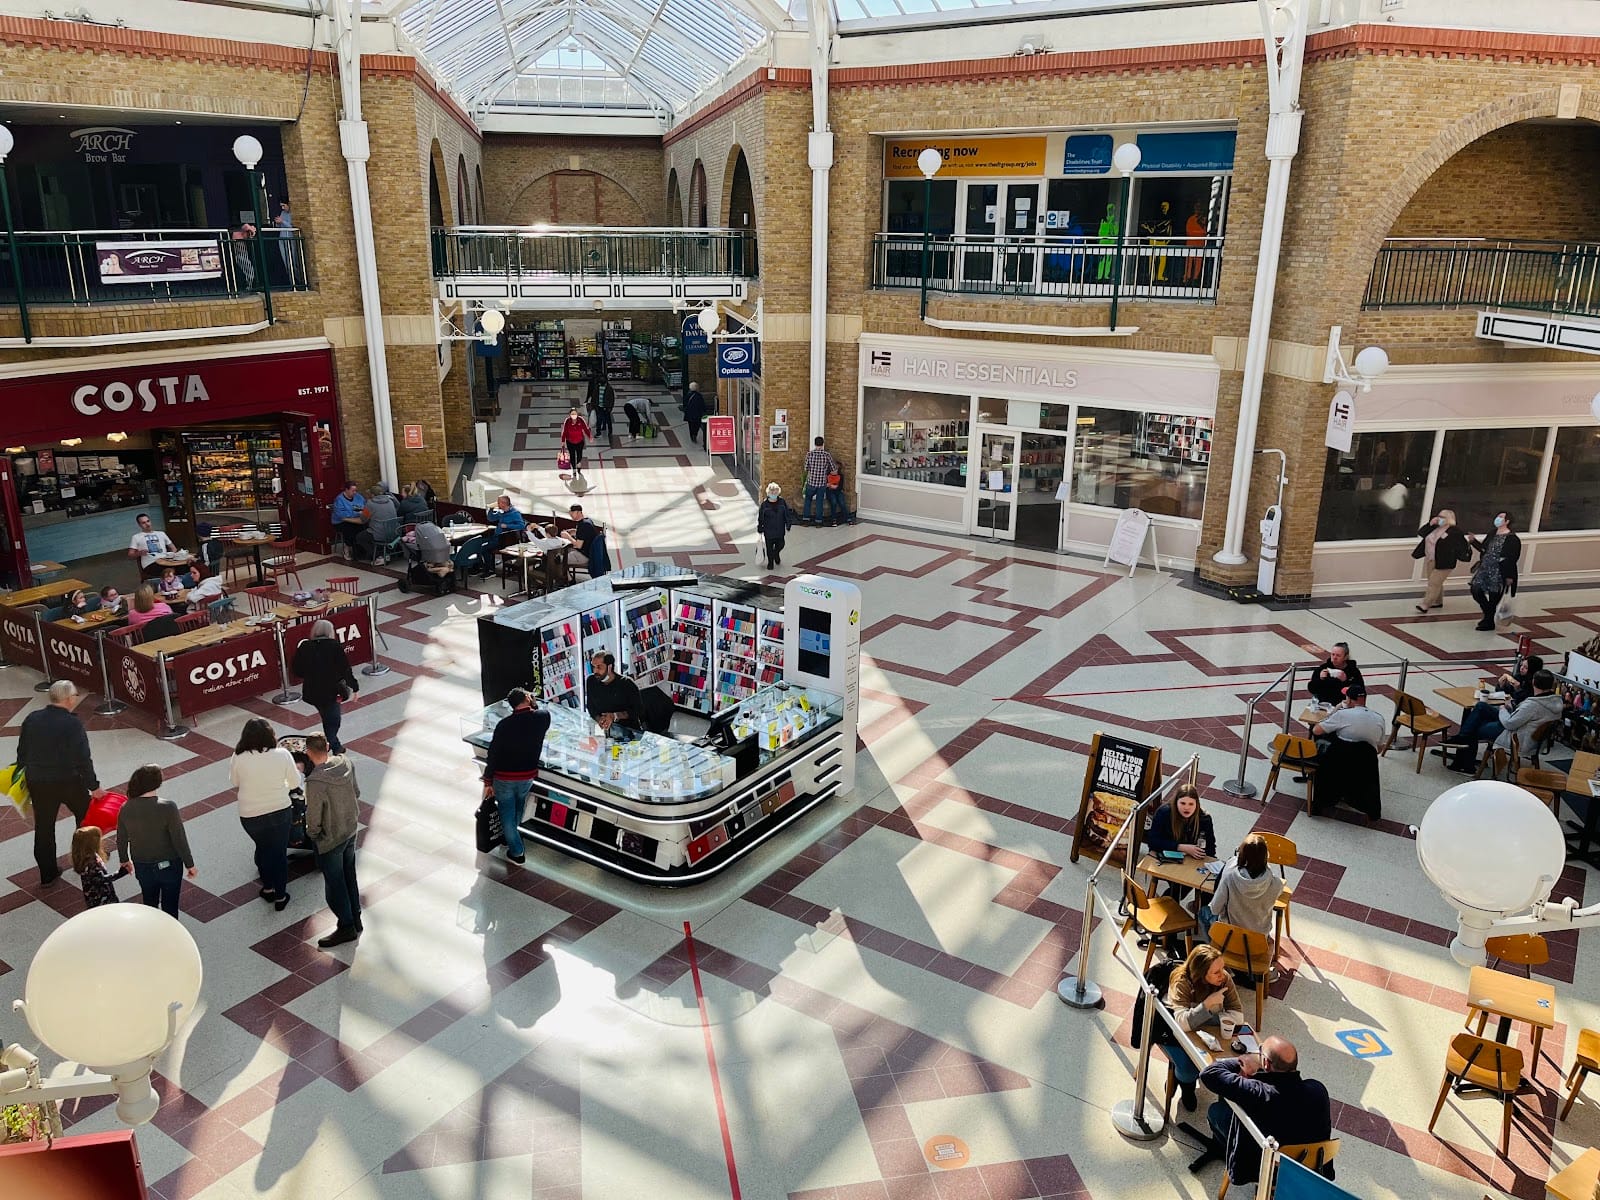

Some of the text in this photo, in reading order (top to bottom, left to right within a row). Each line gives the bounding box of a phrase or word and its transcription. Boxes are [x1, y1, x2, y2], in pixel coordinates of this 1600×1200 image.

[75, 134, 133, 152] ARCH
[893, 145, 978, 160] Recrng now
[85, 153, 126, 162] Brow Bar
[131, 256, 166, 265] ARCH
[721, 367, 750, 375] Opticians
[903, 358, 1078, 388] HAIR ESSENTIALS
[72, 374, 210, 416] COSTA
[298, 385, 329, 396] EST. 1971
[4, 620, 36, 645] COSTA
[50, 638, 93, 667] COSTA
[189, 650, 267, 685] COSTA
[1101, 756, 1142, 776] HUNGER
[1103, 748, 1125, 760] MELTS
[1126, 754, 1144, 766] YOUR
[1097, 767, 1140, 791] AWAY
